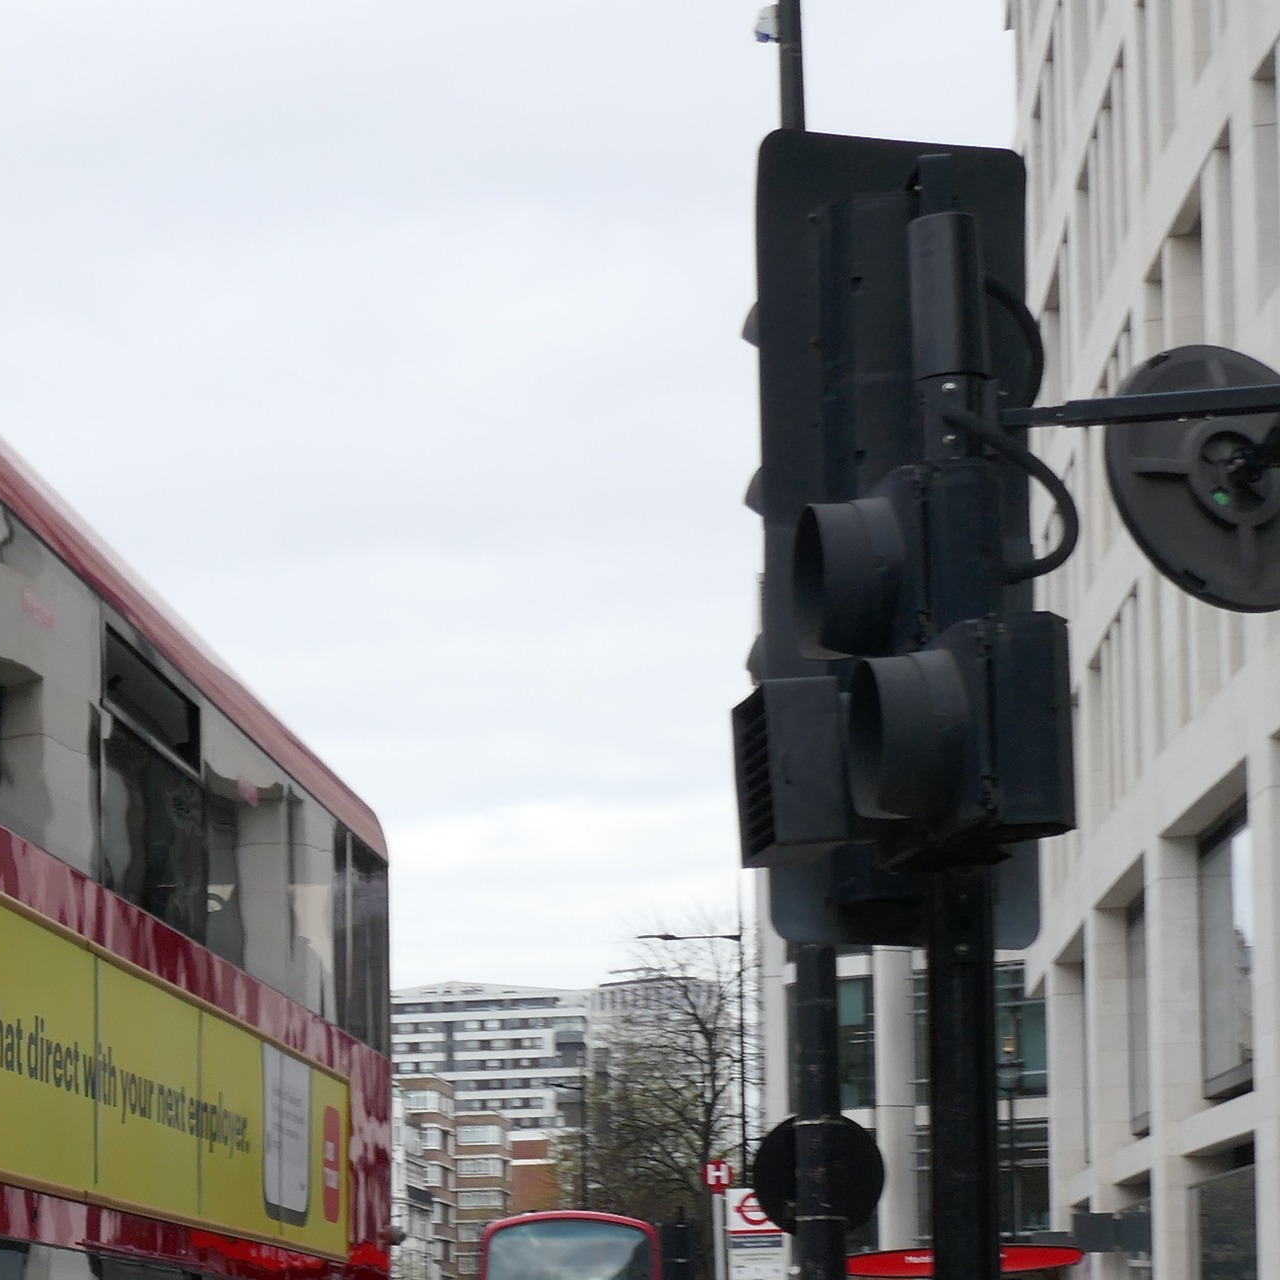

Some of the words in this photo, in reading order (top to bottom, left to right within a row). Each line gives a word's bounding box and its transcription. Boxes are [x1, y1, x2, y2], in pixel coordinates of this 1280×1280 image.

[27, 1015, 80, 1095] direct
[83, 1042, 117, 1108] with
[120, 1069, 154, 1125] your
[157, 1084, 186, 1132] next
[706, 1163, 730, 1185] H
